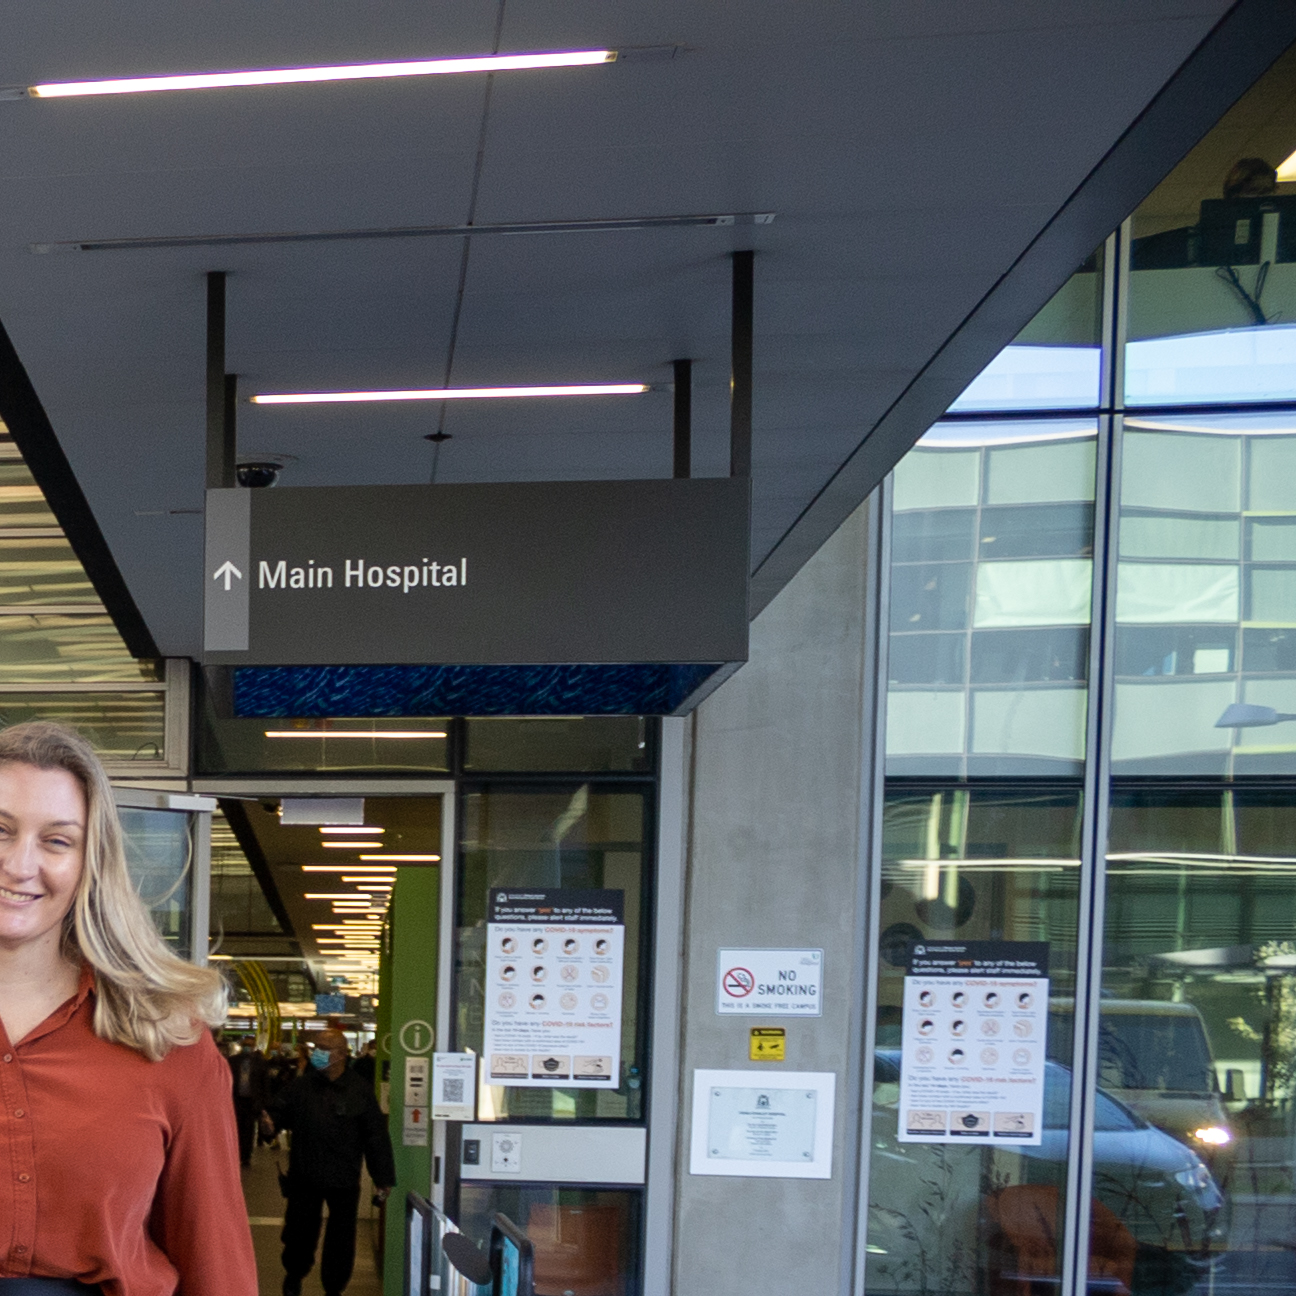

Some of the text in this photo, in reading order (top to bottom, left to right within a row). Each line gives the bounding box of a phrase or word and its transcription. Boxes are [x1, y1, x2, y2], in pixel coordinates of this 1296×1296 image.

[257, 558, 468, 594] Main Hospital
[779, 970, 796, 981] NO
[758, 984, 816, 996] SMOKING
